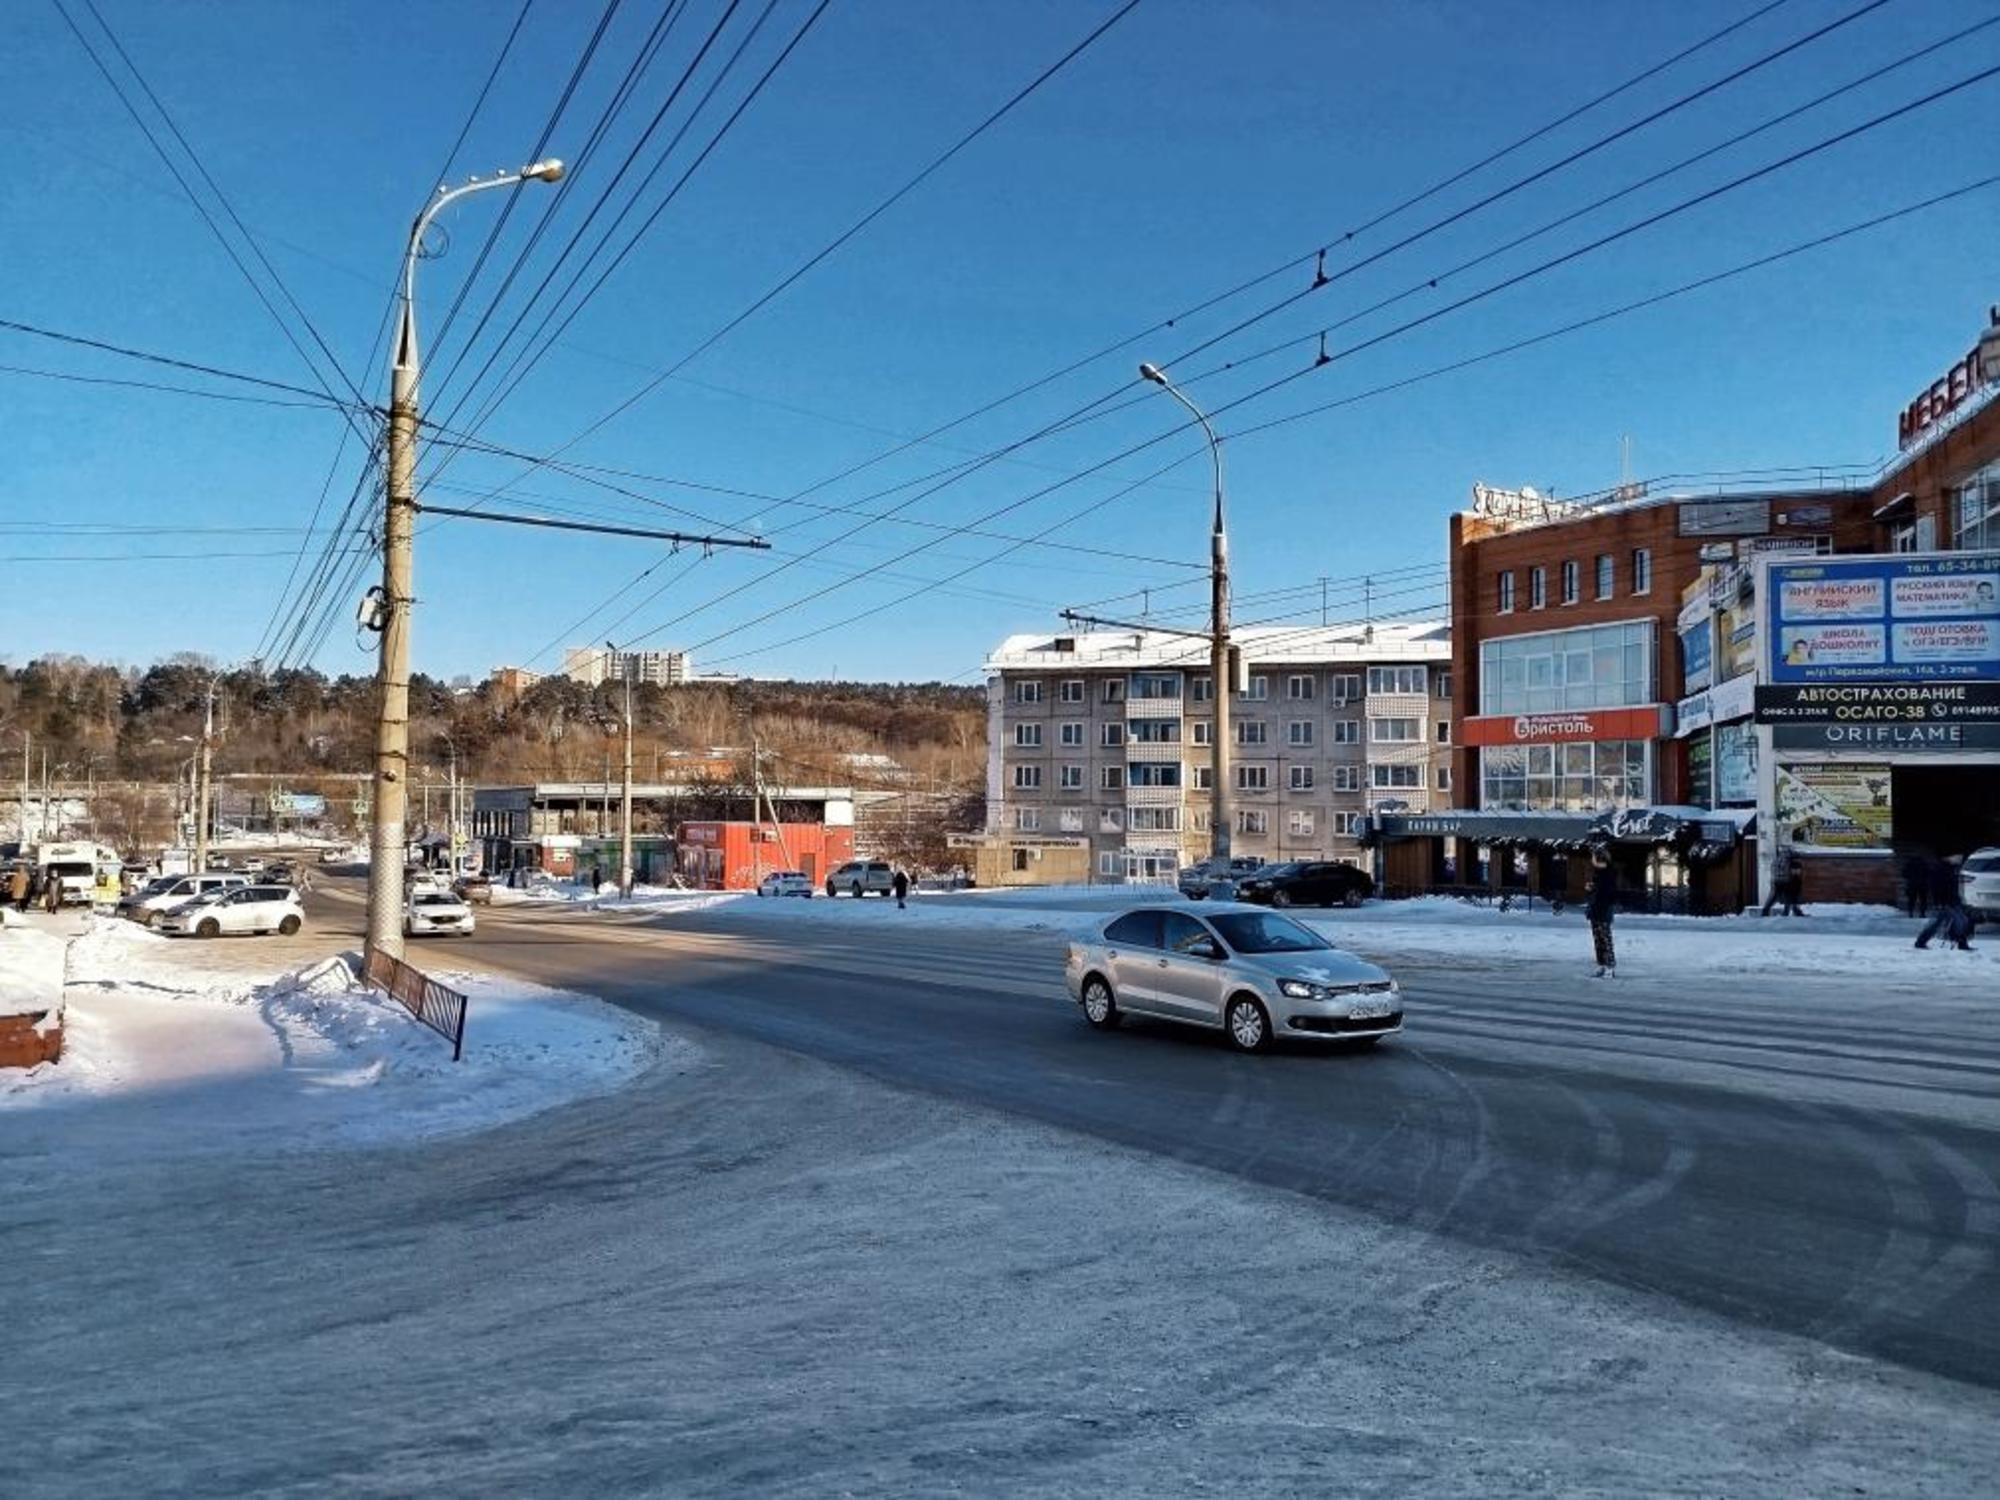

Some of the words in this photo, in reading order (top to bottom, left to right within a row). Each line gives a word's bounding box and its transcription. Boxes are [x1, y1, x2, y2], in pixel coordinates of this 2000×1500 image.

[1815, 599, 1849, 609] ЯЗЫК
[1822, 628, 1866, 639] ШКОЛА
[1796, 687, 1966, 702] АВТОСТРАХОВАНИЕ
[1835, 705, 1926, 719] ОСАГО-38
[1826, 726, 1962, 741] ORIFLAME
